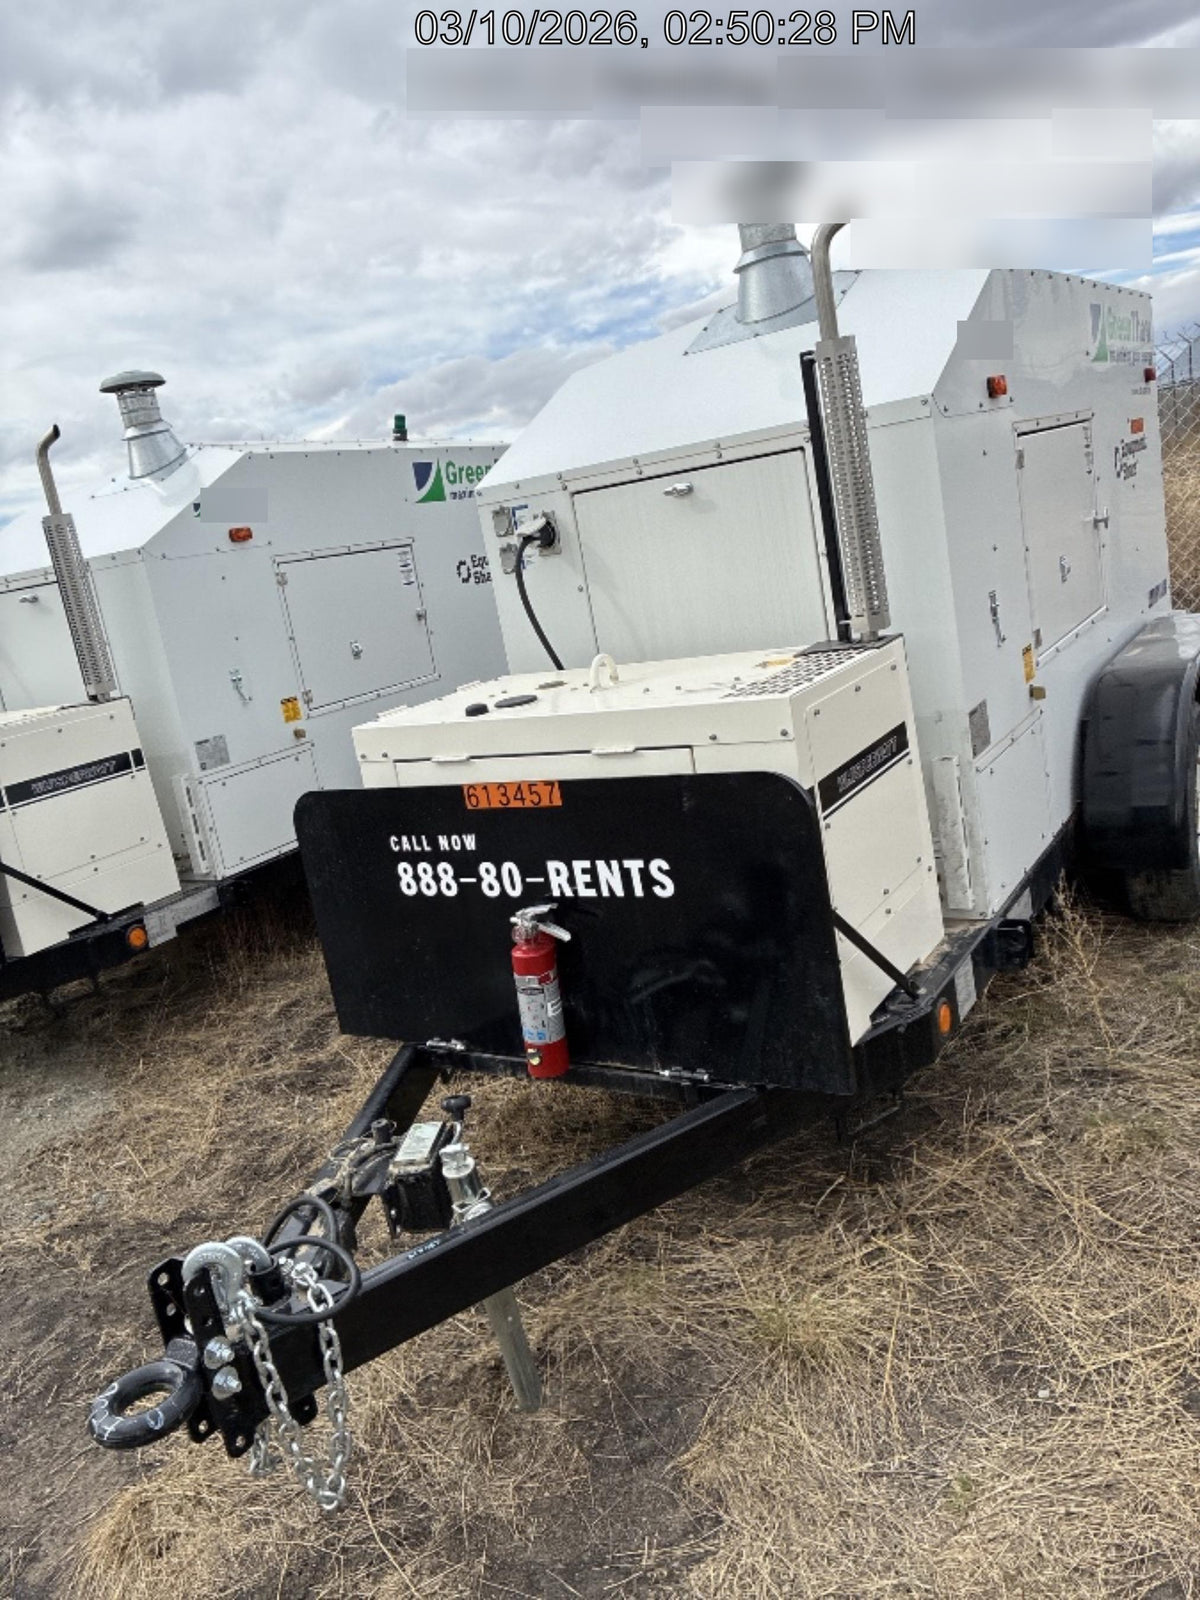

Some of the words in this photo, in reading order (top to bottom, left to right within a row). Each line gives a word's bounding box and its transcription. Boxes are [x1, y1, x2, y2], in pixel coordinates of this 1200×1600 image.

[467, 782, 556, 808] 613457
[390, 835, 431, 851] CALL
[439, 834, 477, 851] NOW
[397, 858, 675, 898] 888-80-RENTS
